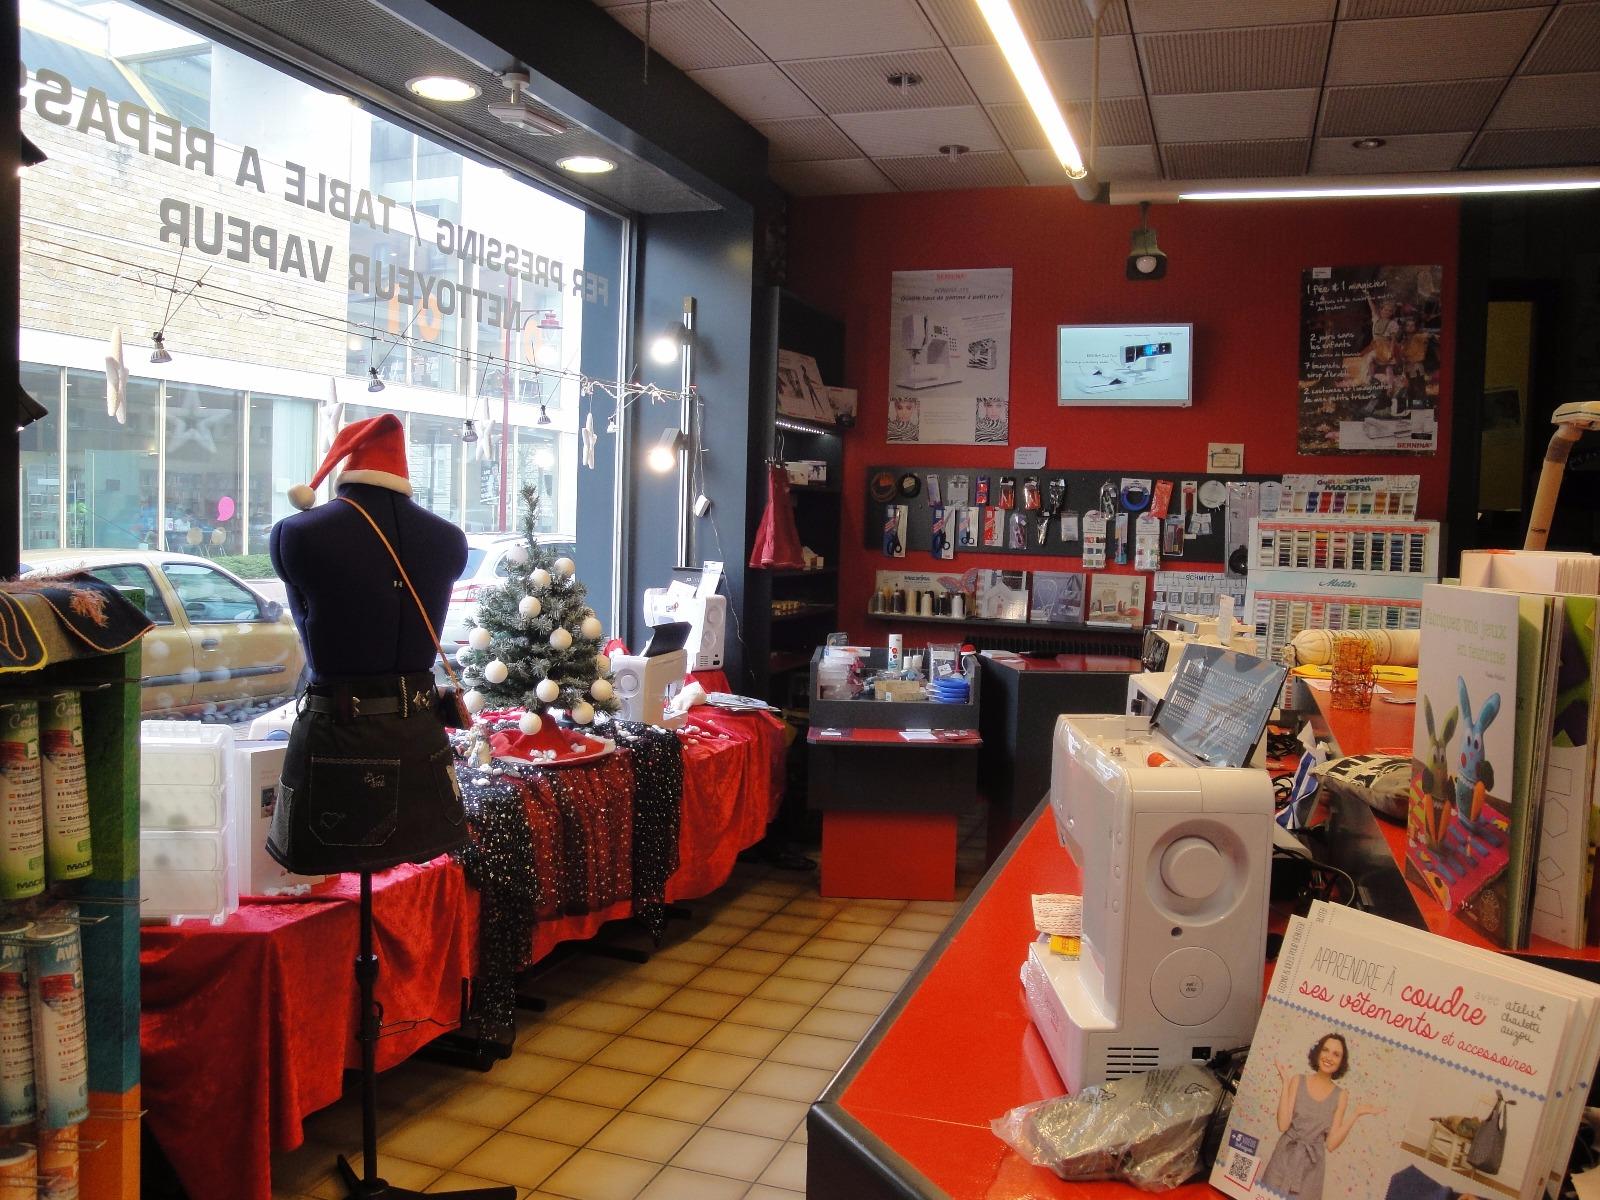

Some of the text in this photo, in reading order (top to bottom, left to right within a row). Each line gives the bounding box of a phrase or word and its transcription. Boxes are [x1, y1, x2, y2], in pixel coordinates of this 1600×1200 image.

[1311, 946, 1386, 993] APPRENDRE
[1385, 963, 1399, 995] À
[1400, 985, 1487, 1026] coudre
[1504, 1000, 1543, 1021] atelier
[1299, 980, 1538, 1076] ses vêtements et accessoires
[1500, 1012, 1542, 1034] charlotte
